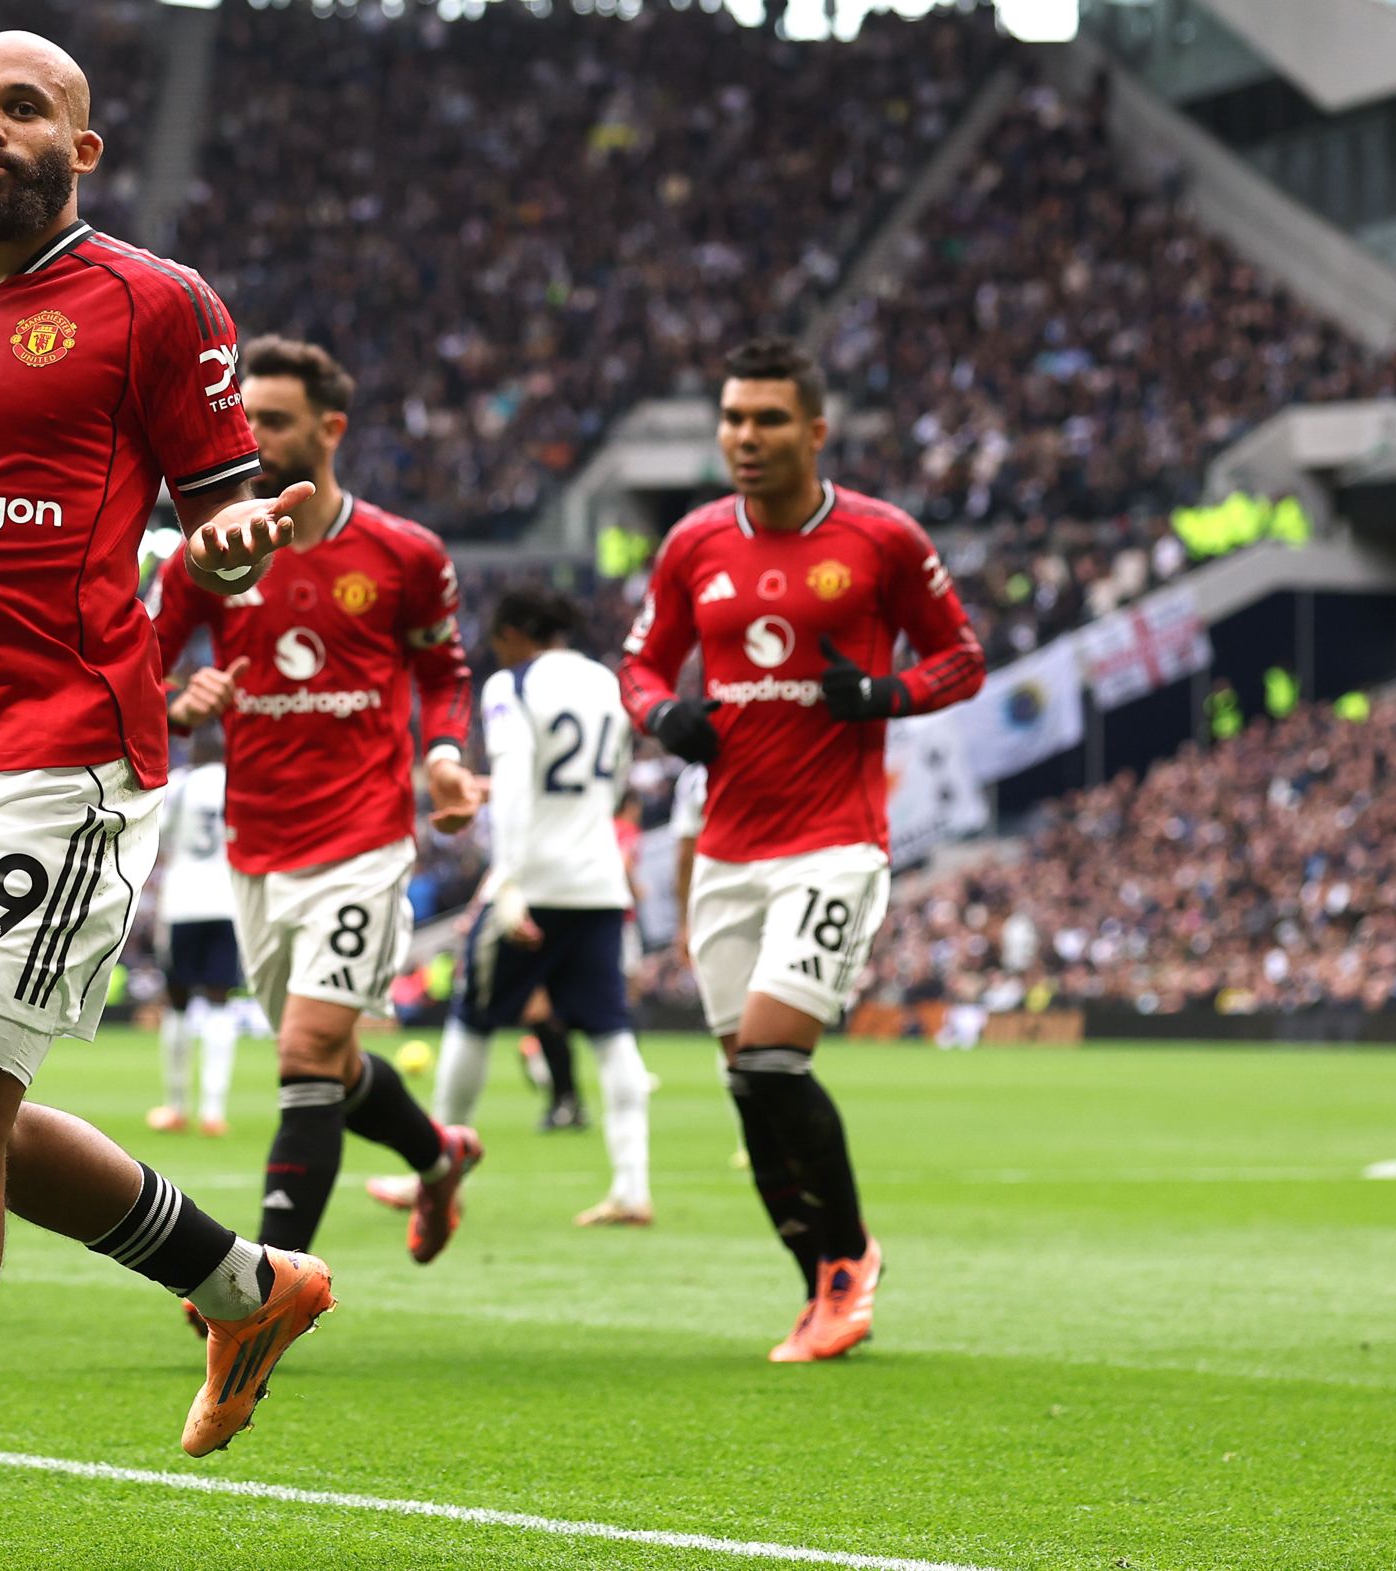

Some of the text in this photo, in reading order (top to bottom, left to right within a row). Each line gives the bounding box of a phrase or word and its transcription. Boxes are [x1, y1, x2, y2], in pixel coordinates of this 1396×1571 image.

[20, 314, 72, 335] MANCHESTER
[20, 351, 56, 363] UNITED
[330, 904, 370, 958] 8
[796, 887, 850, 951] 18
